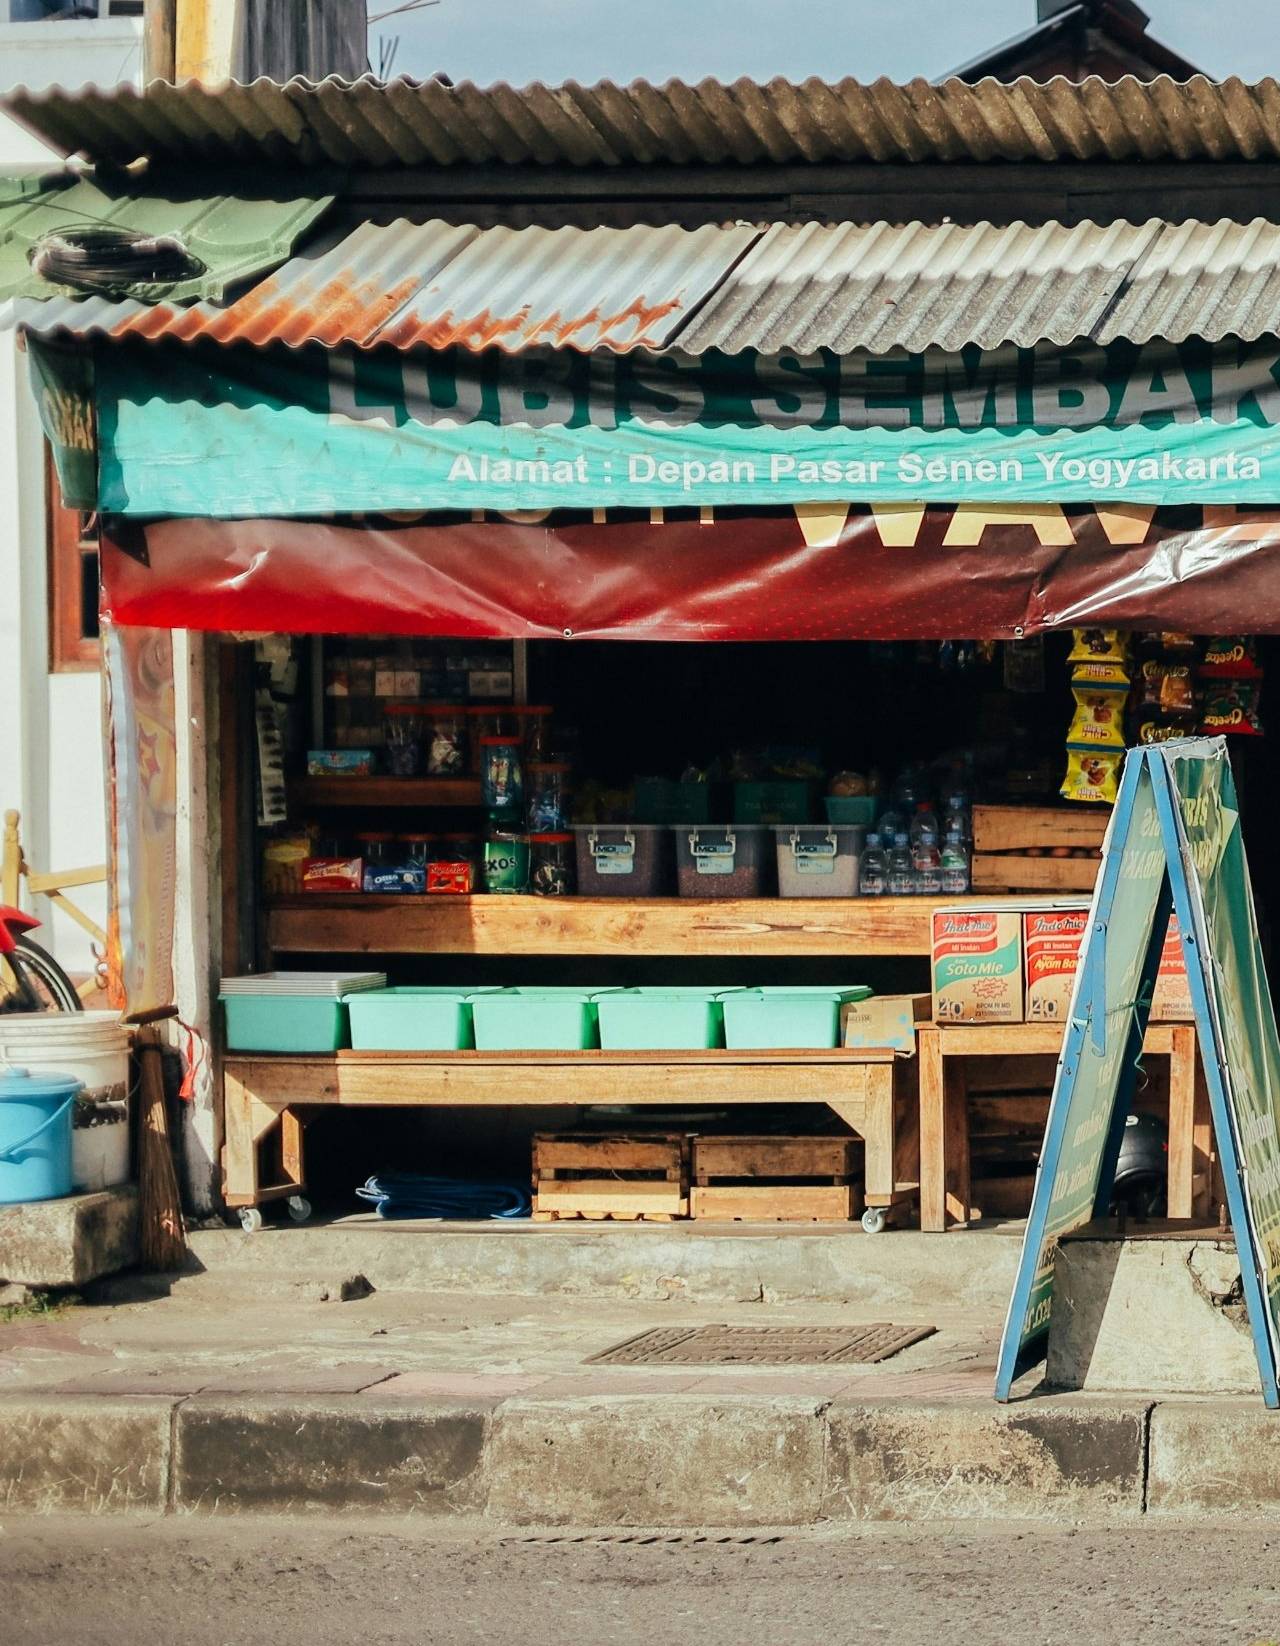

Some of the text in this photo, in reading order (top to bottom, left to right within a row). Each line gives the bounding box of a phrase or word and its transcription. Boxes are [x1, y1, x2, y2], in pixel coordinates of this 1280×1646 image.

[327, 345, 705, 430] LUBIS
[447, 454, 588, 484] Alamat
[628, 454, 756, 491] Depan
[771, 453, 886, 484] Pasar
[898, 452, 1023, 484] Senen
[1038, 451, 1261, 490] Yogyakarta
[1204, 708, 1243, 727] Cheetos
[946, 962, 1004, 976] Soto Mie
[1034, 958, 1062, 971] Ayam
